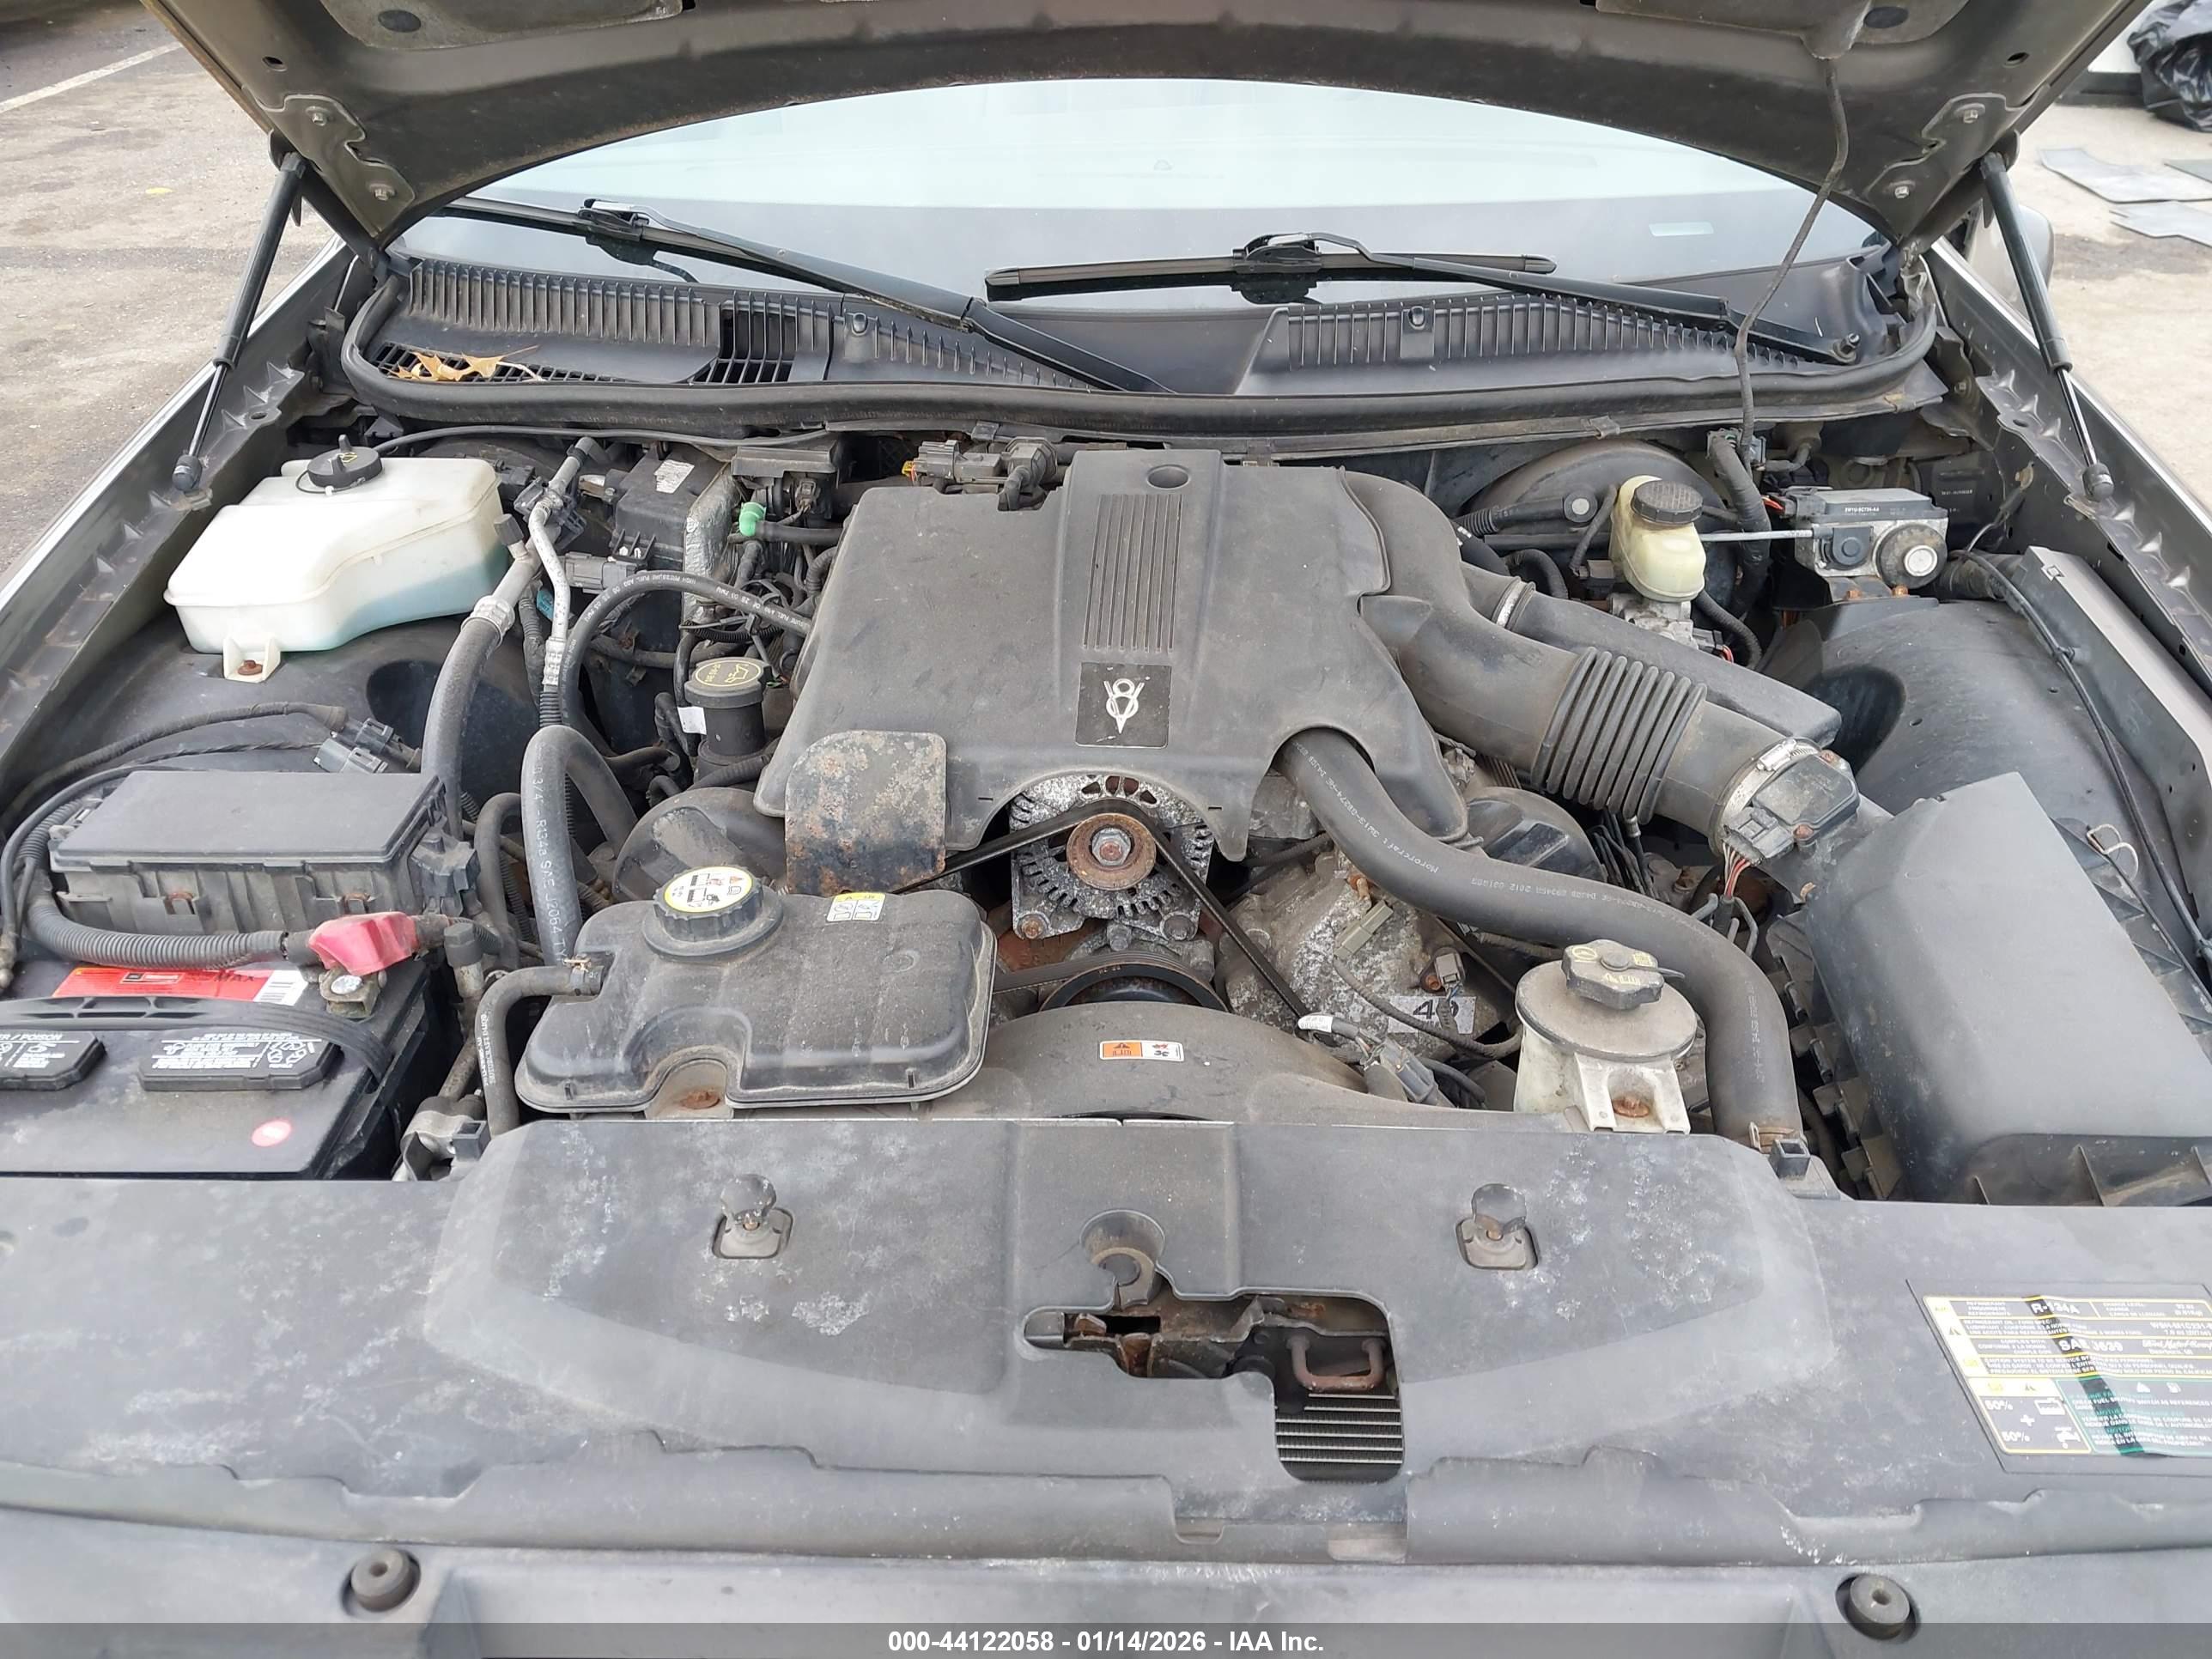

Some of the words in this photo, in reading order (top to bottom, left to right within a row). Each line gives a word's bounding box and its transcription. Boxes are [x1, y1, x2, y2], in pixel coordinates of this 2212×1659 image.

[539, 860, 556, 890] SAE
[544, 893, 563, 934] J2064
[2032, 1300, 2081, 1316] R-134A
